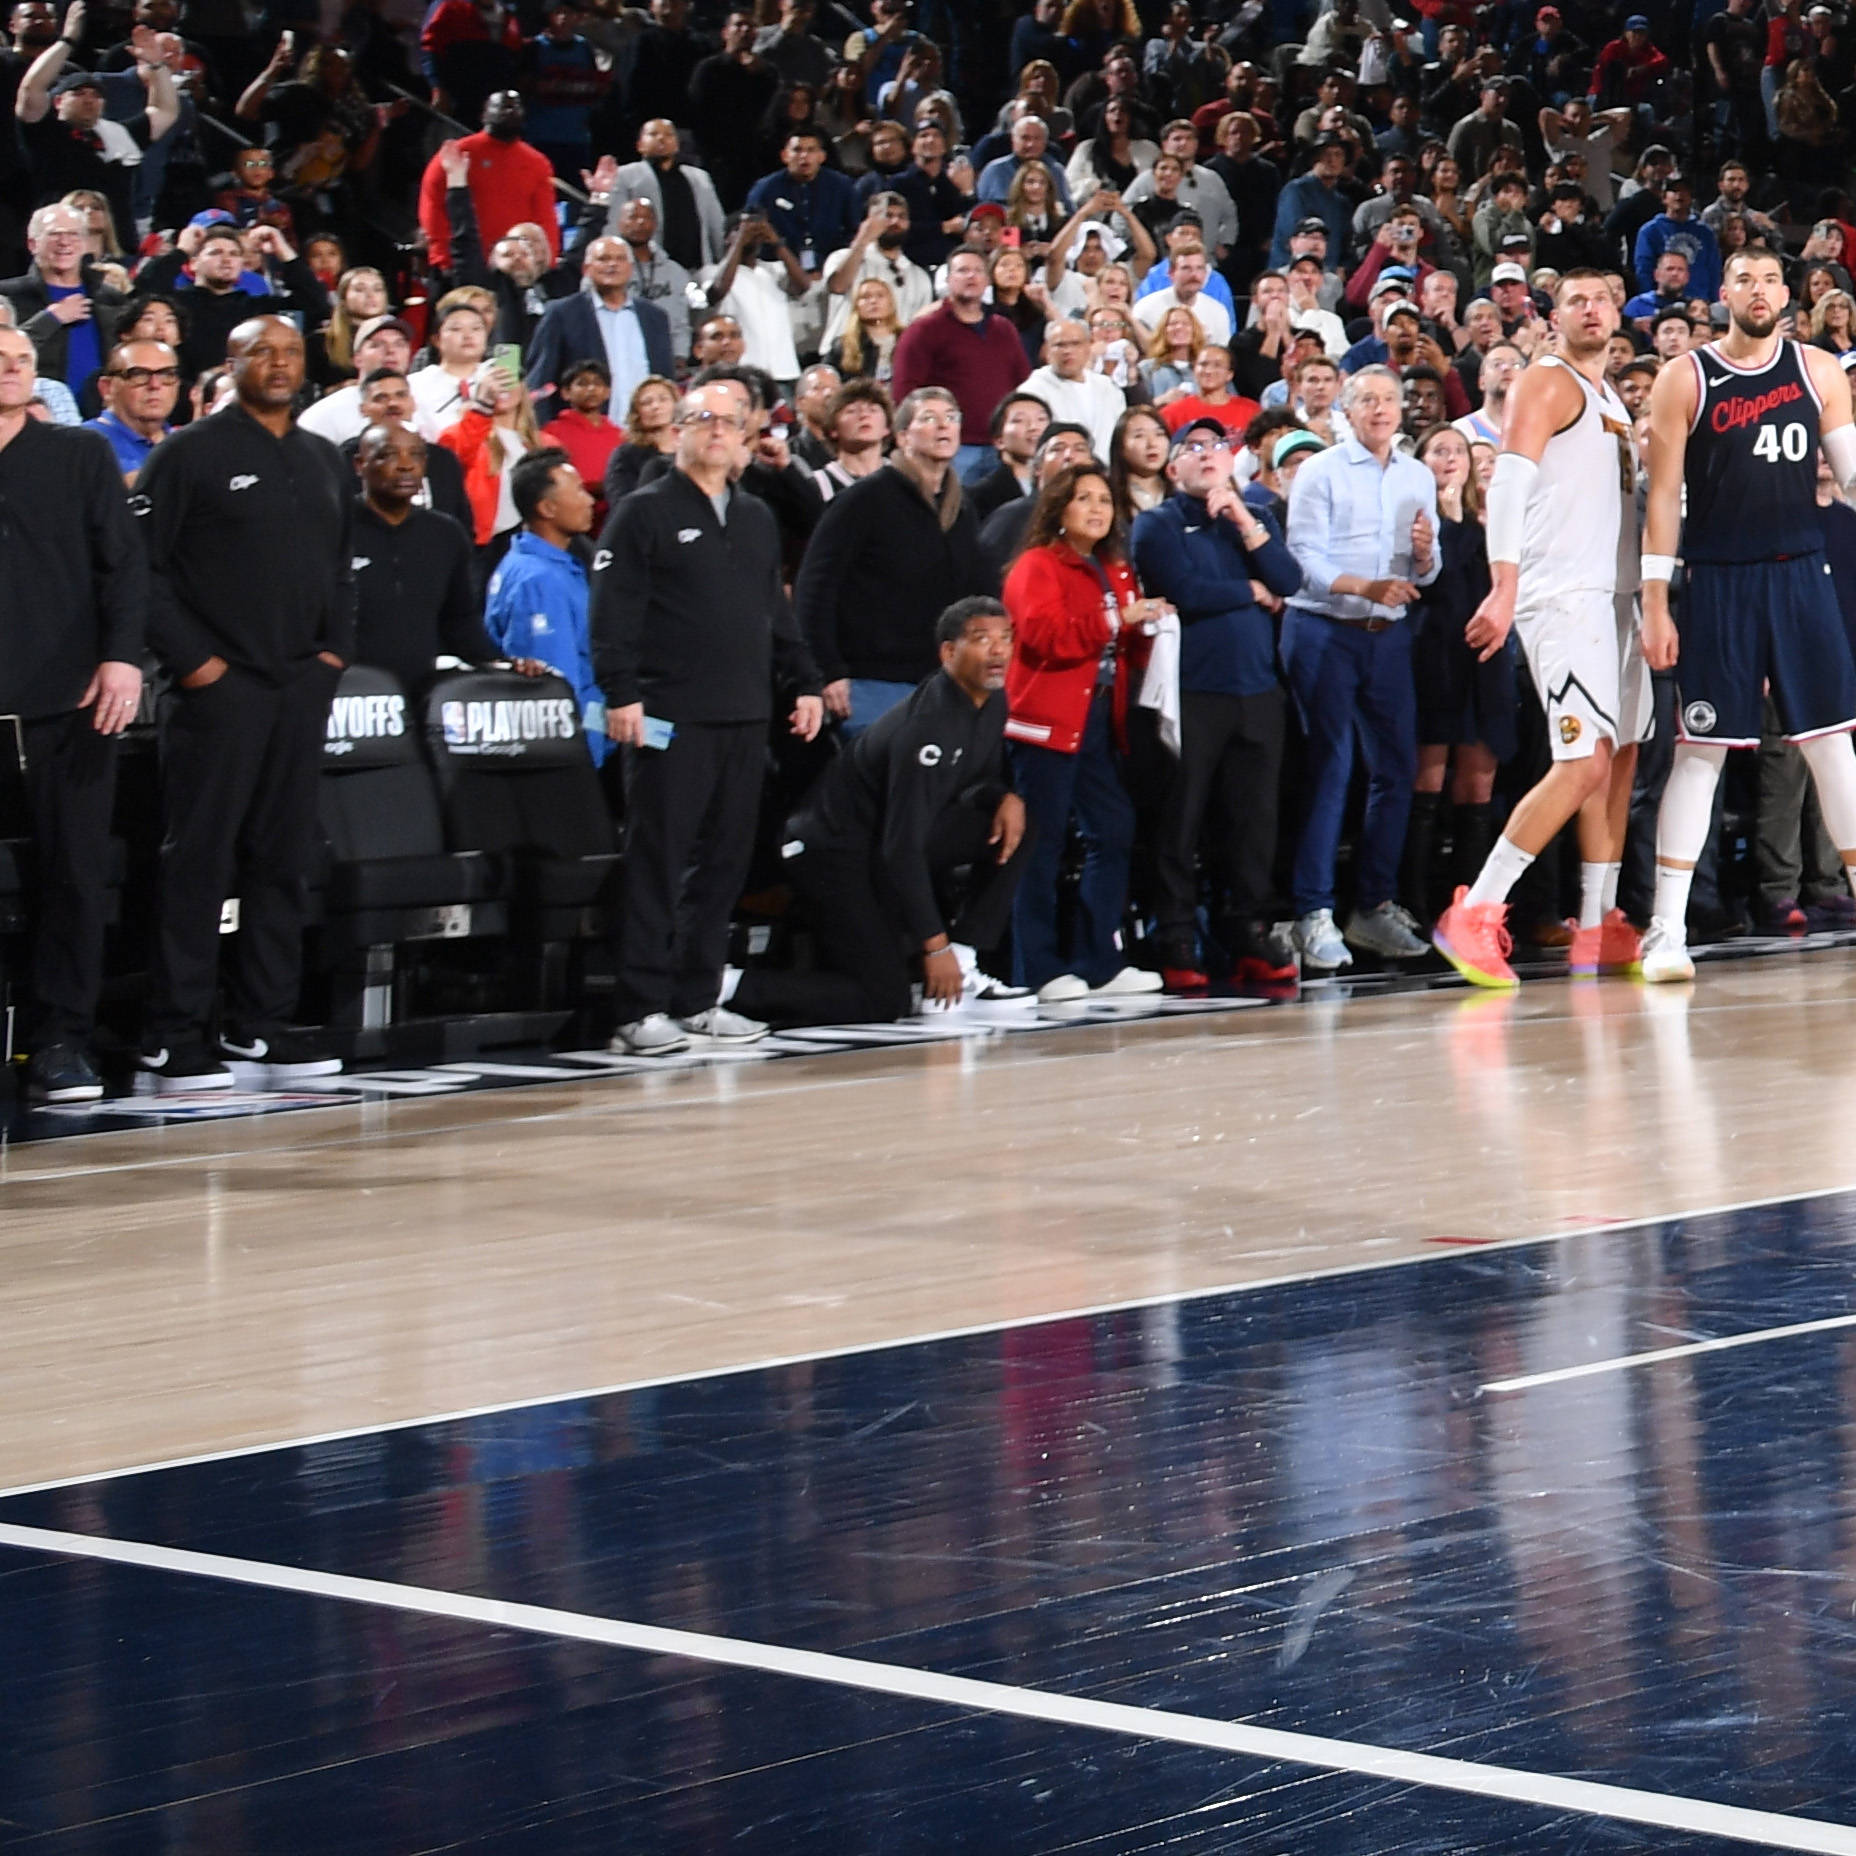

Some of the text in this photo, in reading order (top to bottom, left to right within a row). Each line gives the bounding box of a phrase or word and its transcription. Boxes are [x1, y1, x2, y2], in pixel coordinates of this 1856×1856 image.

[1712, 381, 1803, 434] Clippers
[1753, 422, 1808, 463] 40
[327, 695, 405, 738] YOFFS
[467, 698, 576, 744] PLAYOFFS
